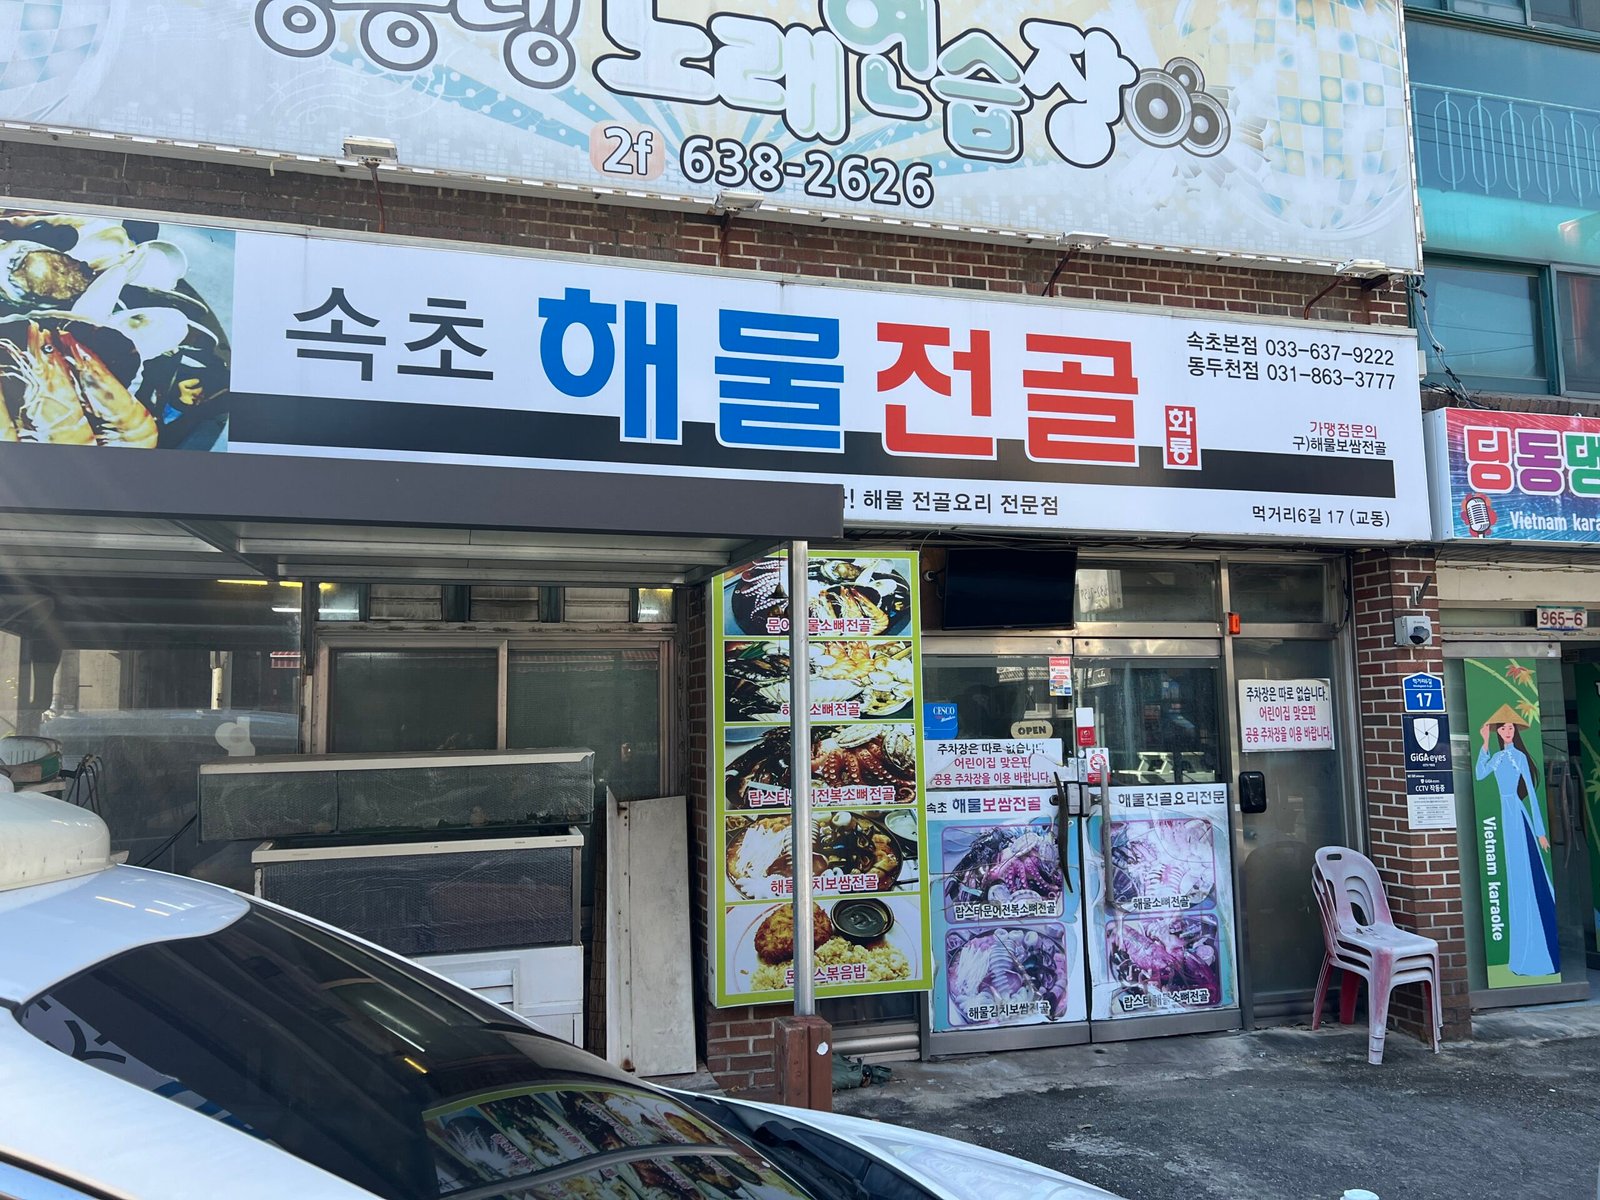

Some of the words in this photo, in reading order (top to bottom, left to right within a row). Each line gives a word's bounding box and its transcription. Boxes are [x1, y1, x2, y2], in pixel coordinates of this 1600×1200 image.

[602, 126, 653, 175] 2f
[679, 134, 934, 208] 638-2626
[285, 287, 494, 382] 속초
[1187, 330, 1257, 356] 속초본점
[1265, 340, 1395, 366] 033-637-9222
[1187, 356, 1259, 380] 동두천점
[1266, 364, 1396, 390] 031-863-3777
[1309, 421, 1378, 440] 가맹점문의
[1292, 436, 1387, 456] 구)해물보쌈전골
[863, 489, 904, 511] 해물
[911, 490, 992, 514] 전골요리
[1000, 495, 1059, 516] 전문점
[1252, 505, 1322, 525] 먹거리6길
[1327, 510, 1345, 524] 17
[1349, 508, 1390, 528] (교동)
[1509, 511, 1568, 531] Vietnam
[1540, 611, 1583, 626] 965-6
[1246, 686, 1277, 702] 주차장은
[1278, 686, 1294, 701] 따로
[1296, 686, 1328, 701] 없습니다.
[1416, 692, 1432, 707] 17
[932, 706, 955, 716] CESCO
[1259, 705, 1291, 721] 어린이집
[1293, 704, 1317, 721] 맞은편
[1017, 725, 1047, 735] OPEN
[1245, 727, 1259, 743] 공용
[1261, 727, 1287, 742] 주차장을
[1289, 726, 1303, 742] 이용
[1304, 725, 1333, 741] 바랍니다.
[937, 742, 978, 755] 주차장은
[981, 742, 1002, 754] 따로
[954, 757, 996, 770] 어린이집
[933, 772, 952, 785] 공용
[955, 772, 991, 785] 주차장을
[993, 772, 1011, 785] 이용
[926, 802, 947, 813] 속초
[1483, 816, 1498, 876] Vietnam
[770, 873, 878, 893] 해물치보쌈전골
[1487, 881, 1504, 942] karaoke
